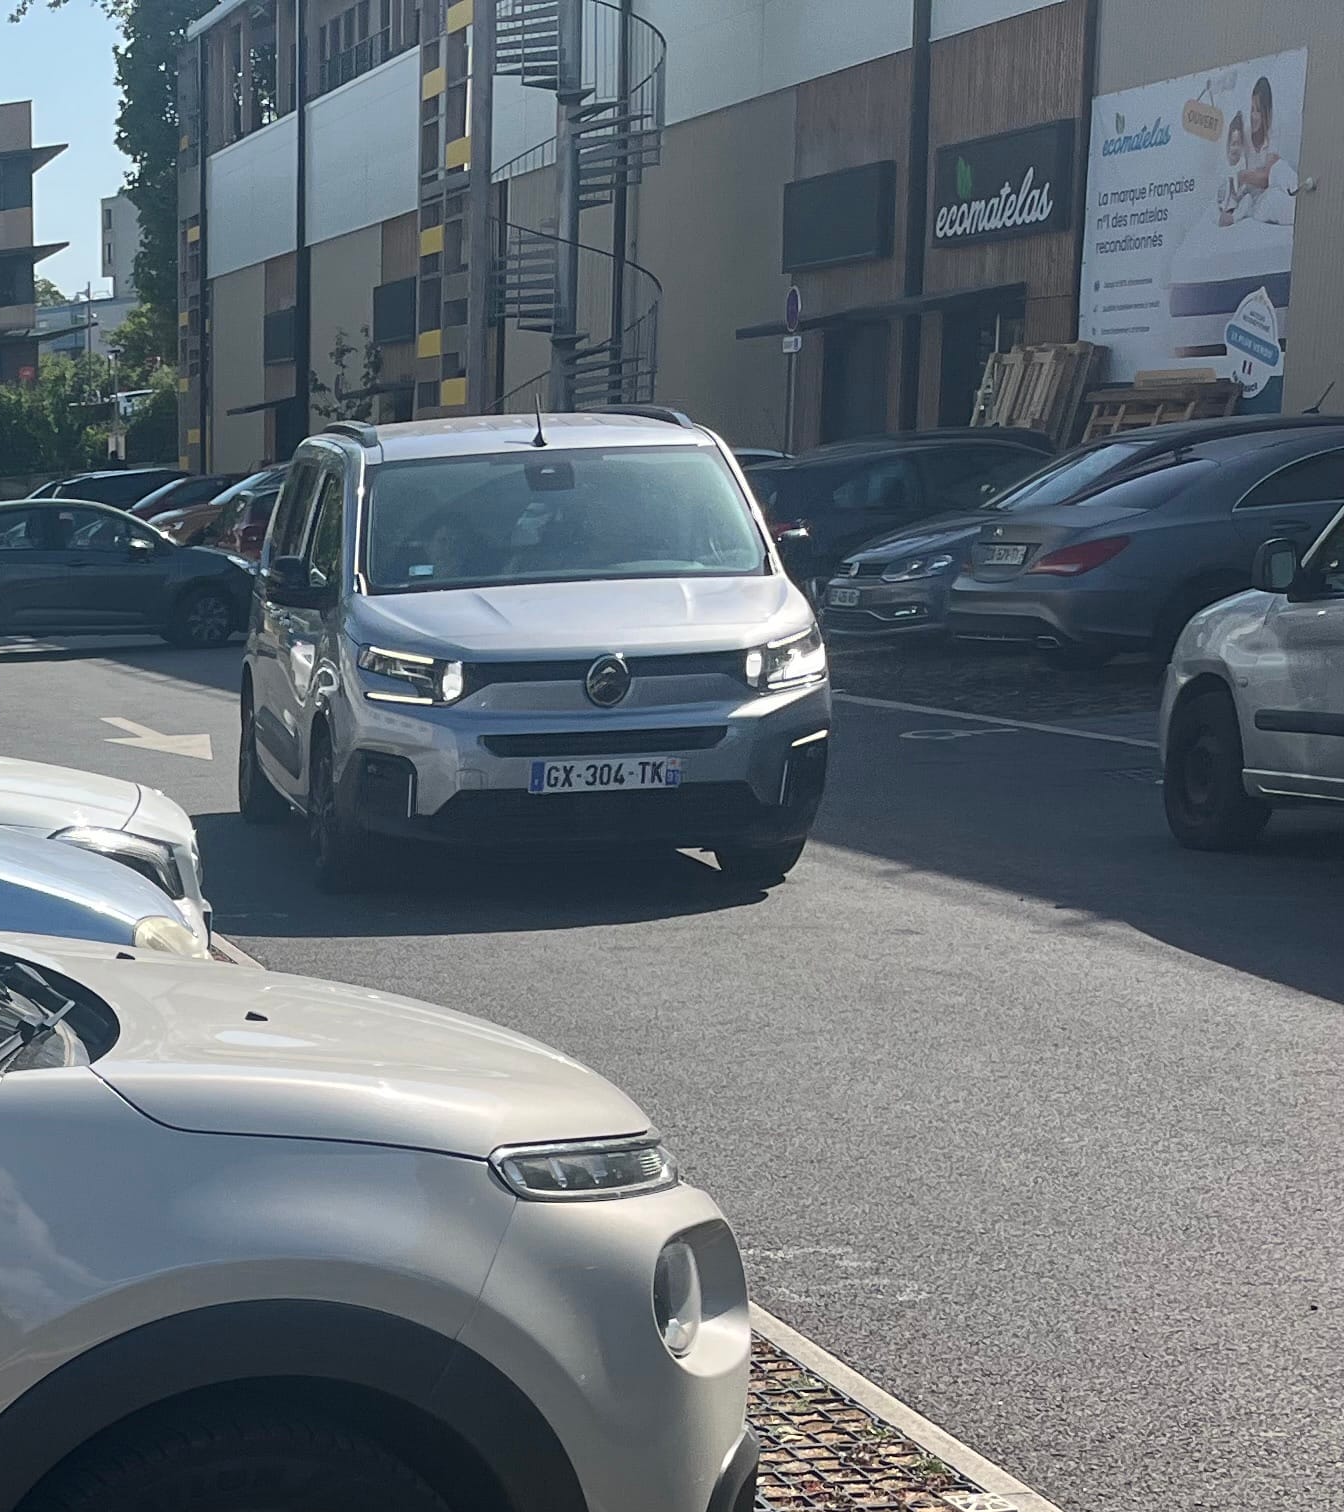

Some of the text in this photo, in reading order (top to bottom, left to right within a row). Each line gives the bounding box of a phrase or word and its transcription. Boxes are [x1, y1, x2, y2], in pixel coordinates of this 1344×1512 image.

[1102, 116, 1171, 157] ecomatelas
[935, 166, 1053, 238] ecomatelas
[1098, 176, 1195, 207] La marque Française
[1111, 211, 1128, 228] des
[1130, 205, 1169, 225] matelas
[1095, 230, 1164, 254] reconditionnés
[546, 761, 664, 788] GX-304-TK
